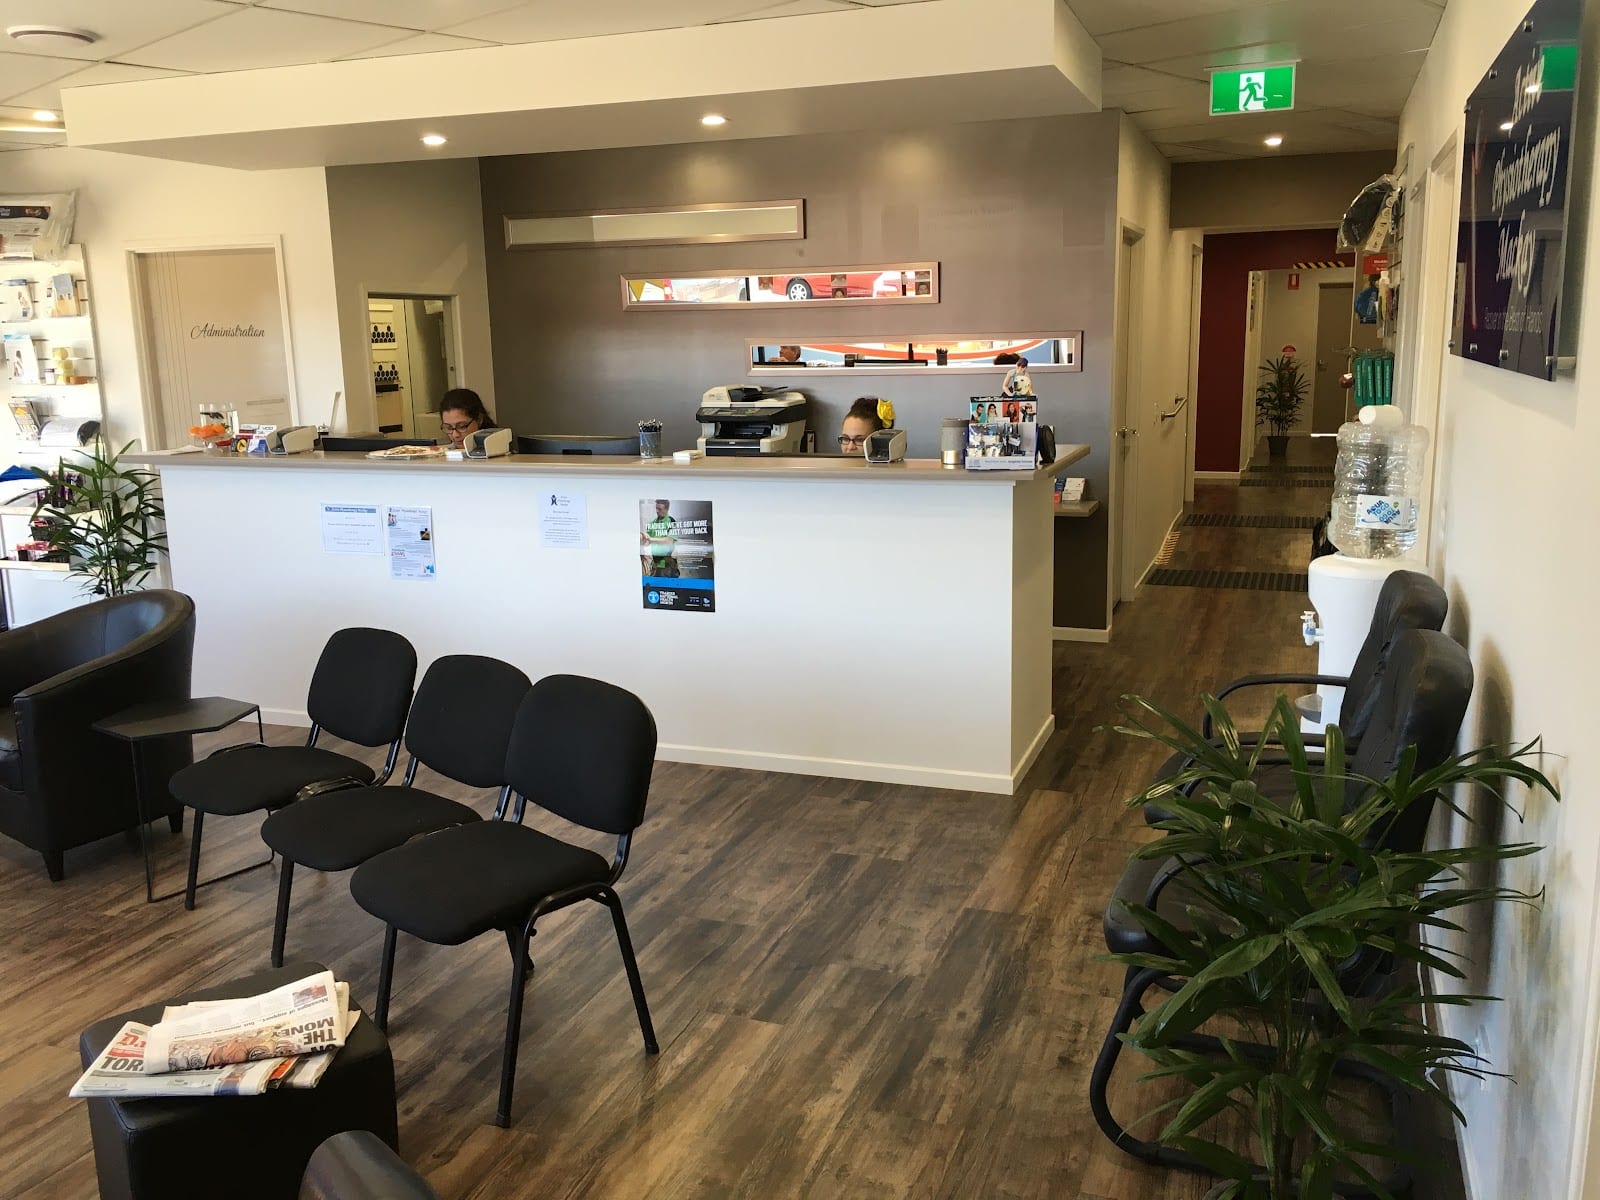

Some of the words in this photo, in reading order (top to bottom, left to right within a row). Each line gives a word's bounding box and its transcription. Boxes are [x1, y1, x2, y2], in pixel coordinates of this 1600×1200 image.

[1508, 47, 1545, 139] Active
[1491, 125, 1561, 227] Physiotherapy
[1495, 208, 1536, 299] Mackay
[190, 322, 266, 340] Administration
[693, 519, 708, 527] MORE
[271, 1016, 335, 1038] MONEY
[303, 1028, 337, 1046] THE
[100, 1056, 145, 1072] TOR
